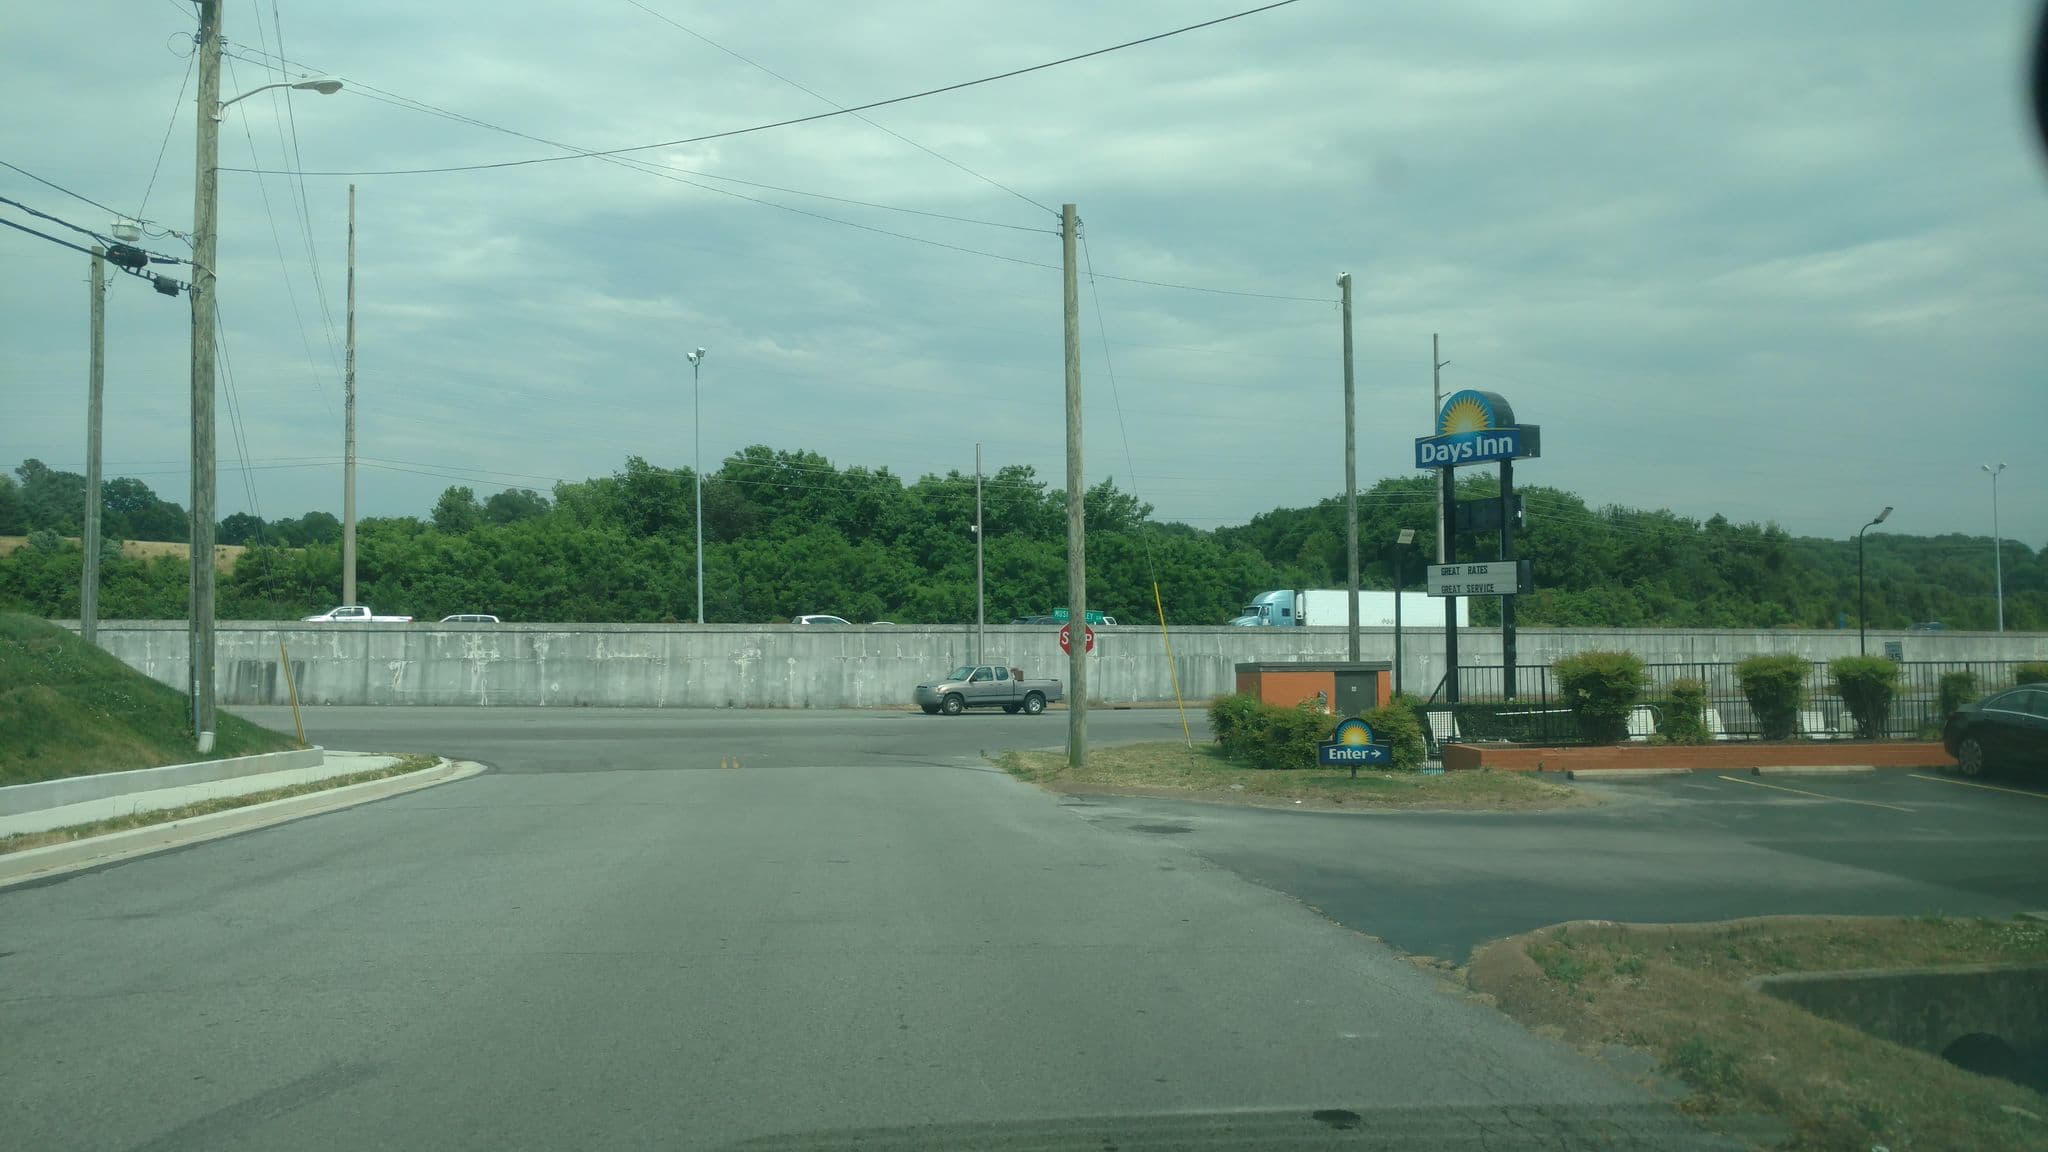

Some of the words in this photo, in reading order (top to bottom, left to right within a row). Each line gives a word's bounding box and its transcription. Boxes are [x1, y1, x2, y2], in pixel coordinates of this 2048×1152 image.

[1421, 442, 1473, 463] Days
[1476, 436, 1513, 456] Inn
[1440, 567, 1460, 576] GREAT
[1467, 565, 1488, 576] RATES
[1441, 585, 1460, 594] GREAT
[1466, 583, 1495, 593] SERVICE
[1061, 632, 1092, 645] SP
[1328, 748, 1369, 760] Enter
